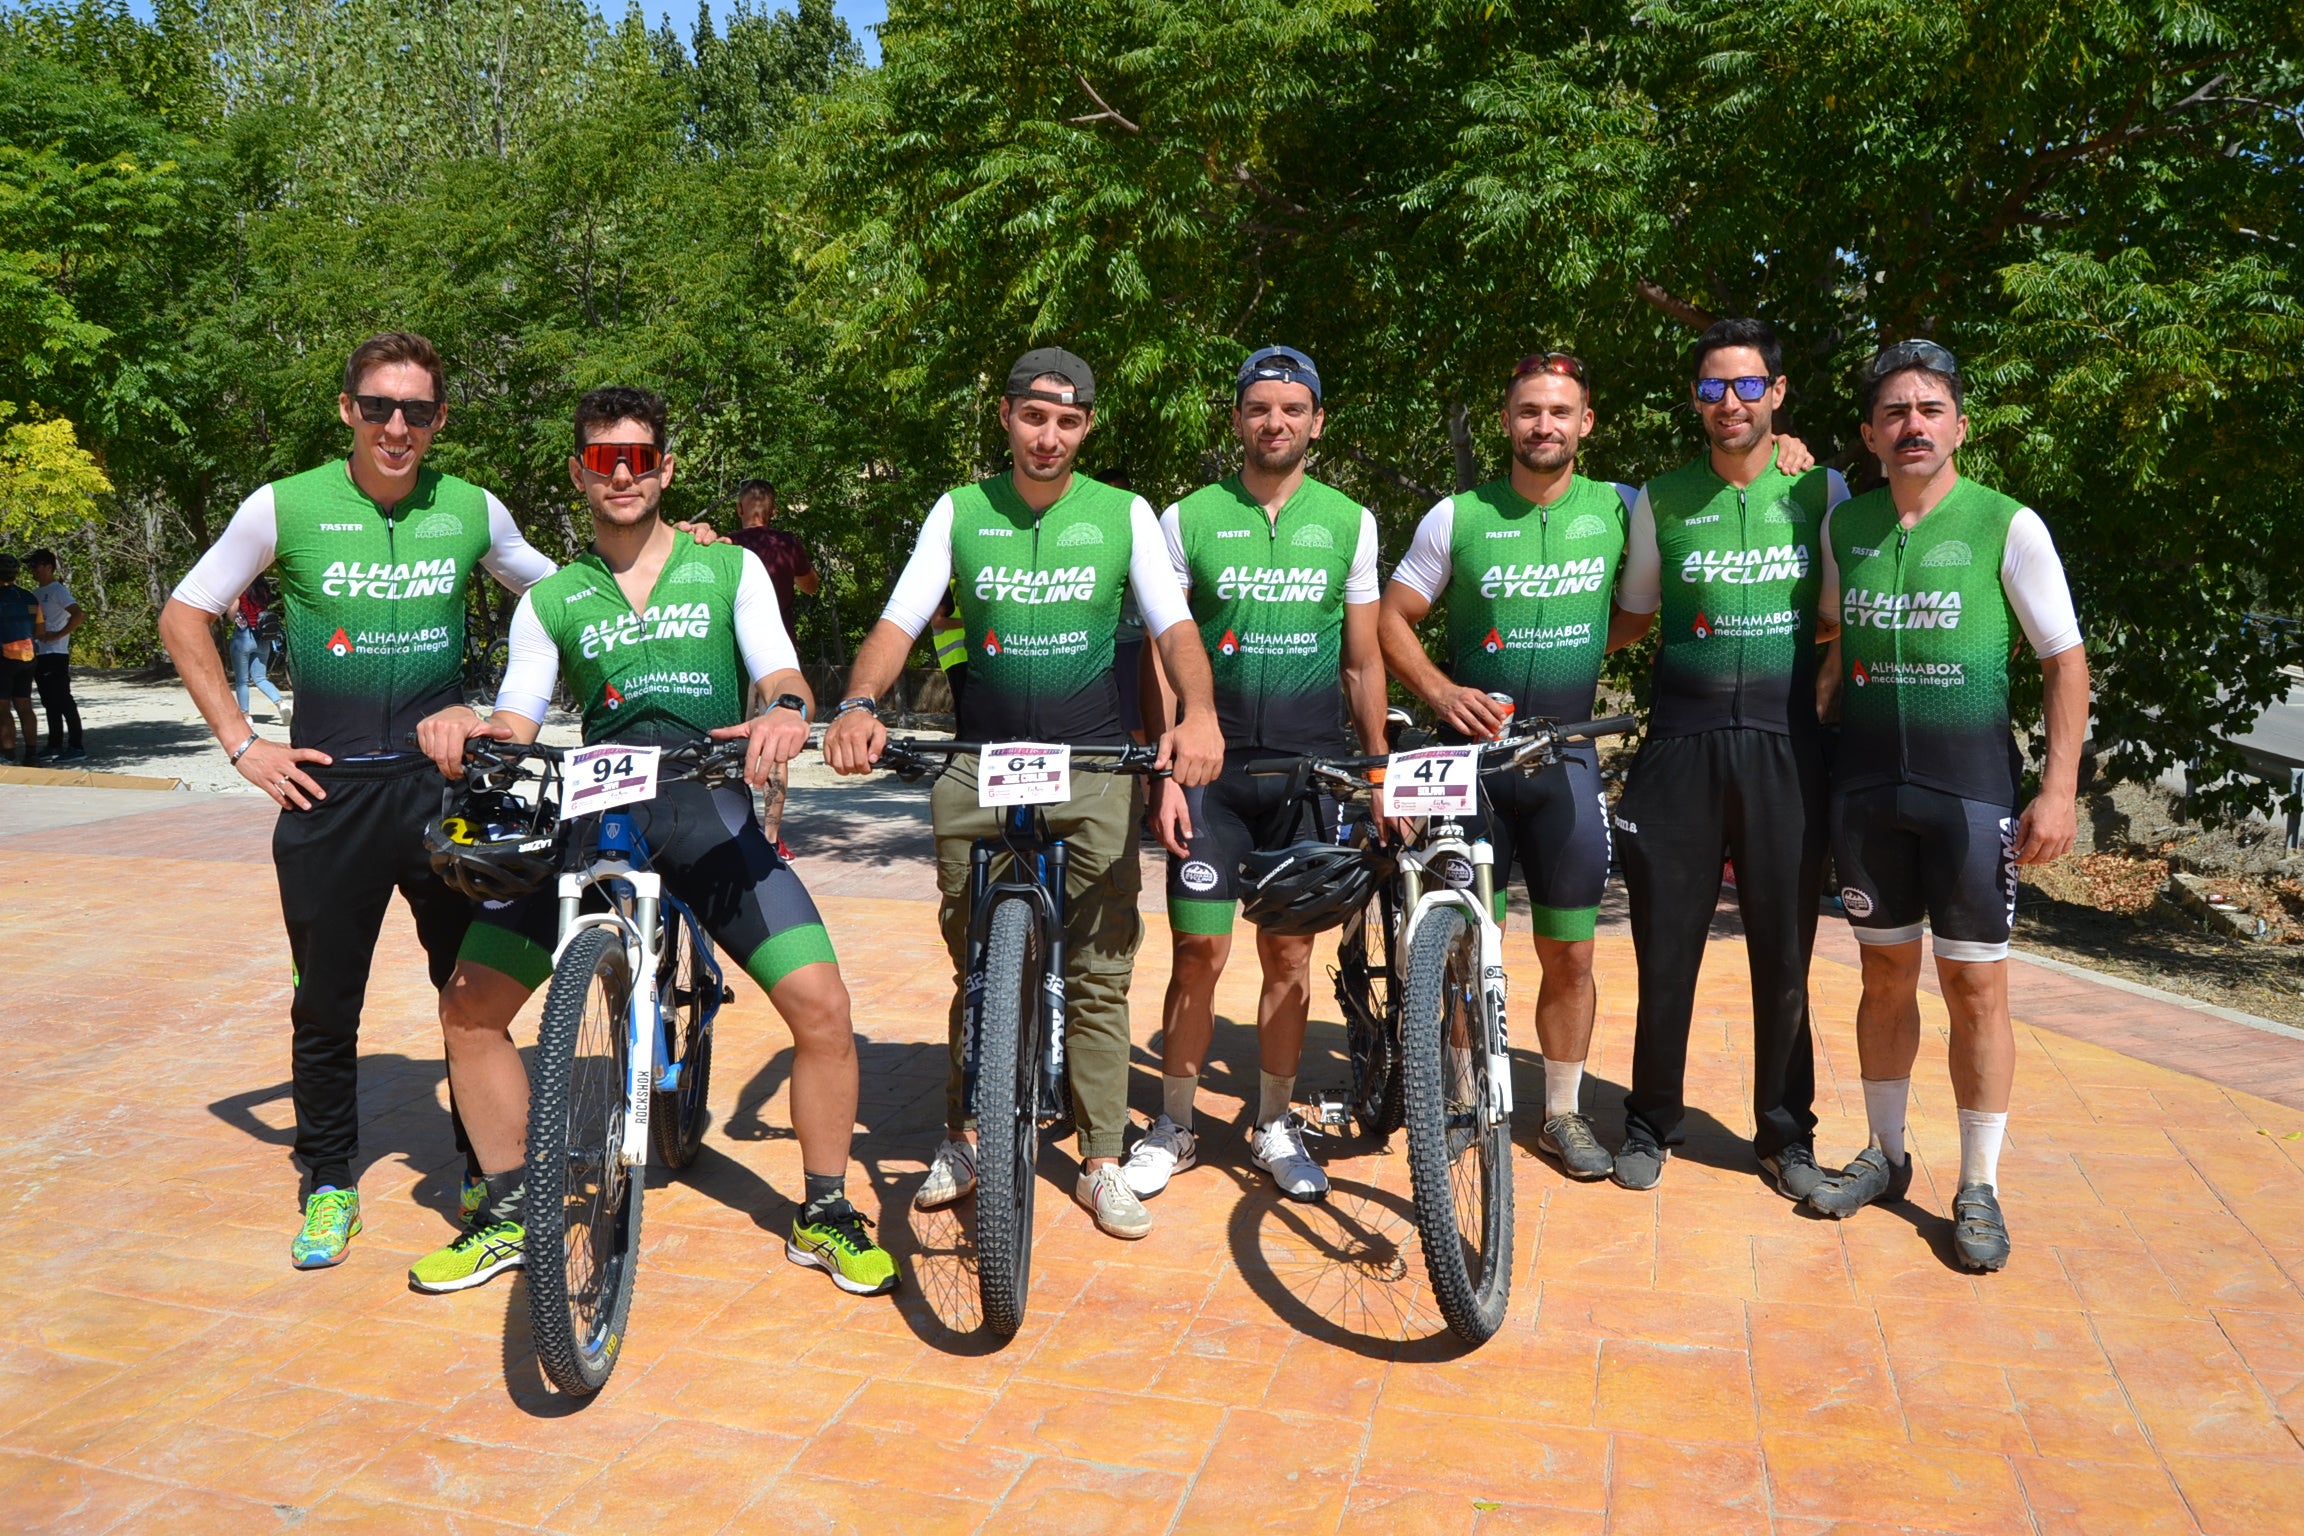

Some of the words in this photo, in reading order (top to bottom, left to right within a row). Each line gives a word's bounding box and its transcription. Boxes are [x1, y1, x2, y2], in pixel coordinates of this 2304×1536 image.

[320, 524, 363, 532] FASTER
[1685, 514, 1720, 526] FASTER
[978, 529, 1013, 537] FASTER
[1217, 530, 1250, 538] FASTER
[1486, 530, 1520, 538] FASTER
[1682, 544, 1809, 566] ALHAMA
[1851, 546, 1880, 558] FASTER
[322, 558, 456, 580] ALHAMA
[975, 566, 1096, 586] ALHAMA
[1217, 566, 1328, 584] ALHAMA
[1480, 556, 1604, 582] ALHAMA
[1681, 561, 1810, 584] CYCLING
[322, 576, 455, 600] CYCLING
[976, 584, 1096, 604] CYCLING
[1217, 584, 1327, 602] CYCLING
[1480, 574, 1604, 598] CYCLING
[566, 587, 597, 604] FASTER
[1844, 588, 1962, 610] ALHAMA
[580, 603, 710, 644] ALHAMA
[1714, 609, 1800, 627] ALHAMABOX
[1844, 607, 1962, 629] CYCLING
[357, 627, 448, 644] ALHAMABOX
[1004, 630, 1088, 646] ALHAMABOX
[1242, 632, 1318, 644] ALHAMABOX
[1508, 623, 1591, 638] ALHAMABOX
[1714, 627, 1763, 636] mecánica
[1767, 623, 1800, 636] integral
[356, 645, 409, 654] mecánica
[414, 637, 449, 652] integral
[582, 621, 710, 659] CYCLING
[1004, 647, 1048, 656] mecánica
[1053, 640, 1088, 655] integral
[1506, 640, 1552, 649] mecánica
[1557, 634, 1590, 648] integral
[1240, 644, 1284, 654] mecánica
[1287, 644, 1318, 656] integral
[1871, 662, 1962, 674] ALHAMABOX
[624, 672, 710, 691] ALHAMABOX
[1920, 674, 1964, 687] integral
[625, 684, 669, 700] mecánica
[674, 685, 712, 697] integral
[593, 755, 633, 783] 94
[1008, 757, 1046, 772] 64
[1414, 759, 1454, 783] 47
[518, 839, 552, 852] LAZER
[966, 971, 984, 991] 32
[1046, 972, 1064, 992] 32
[1051, 1008, 1065, 1064] FOX
[635, 1070, 650, 1124] ROCKSHOX
